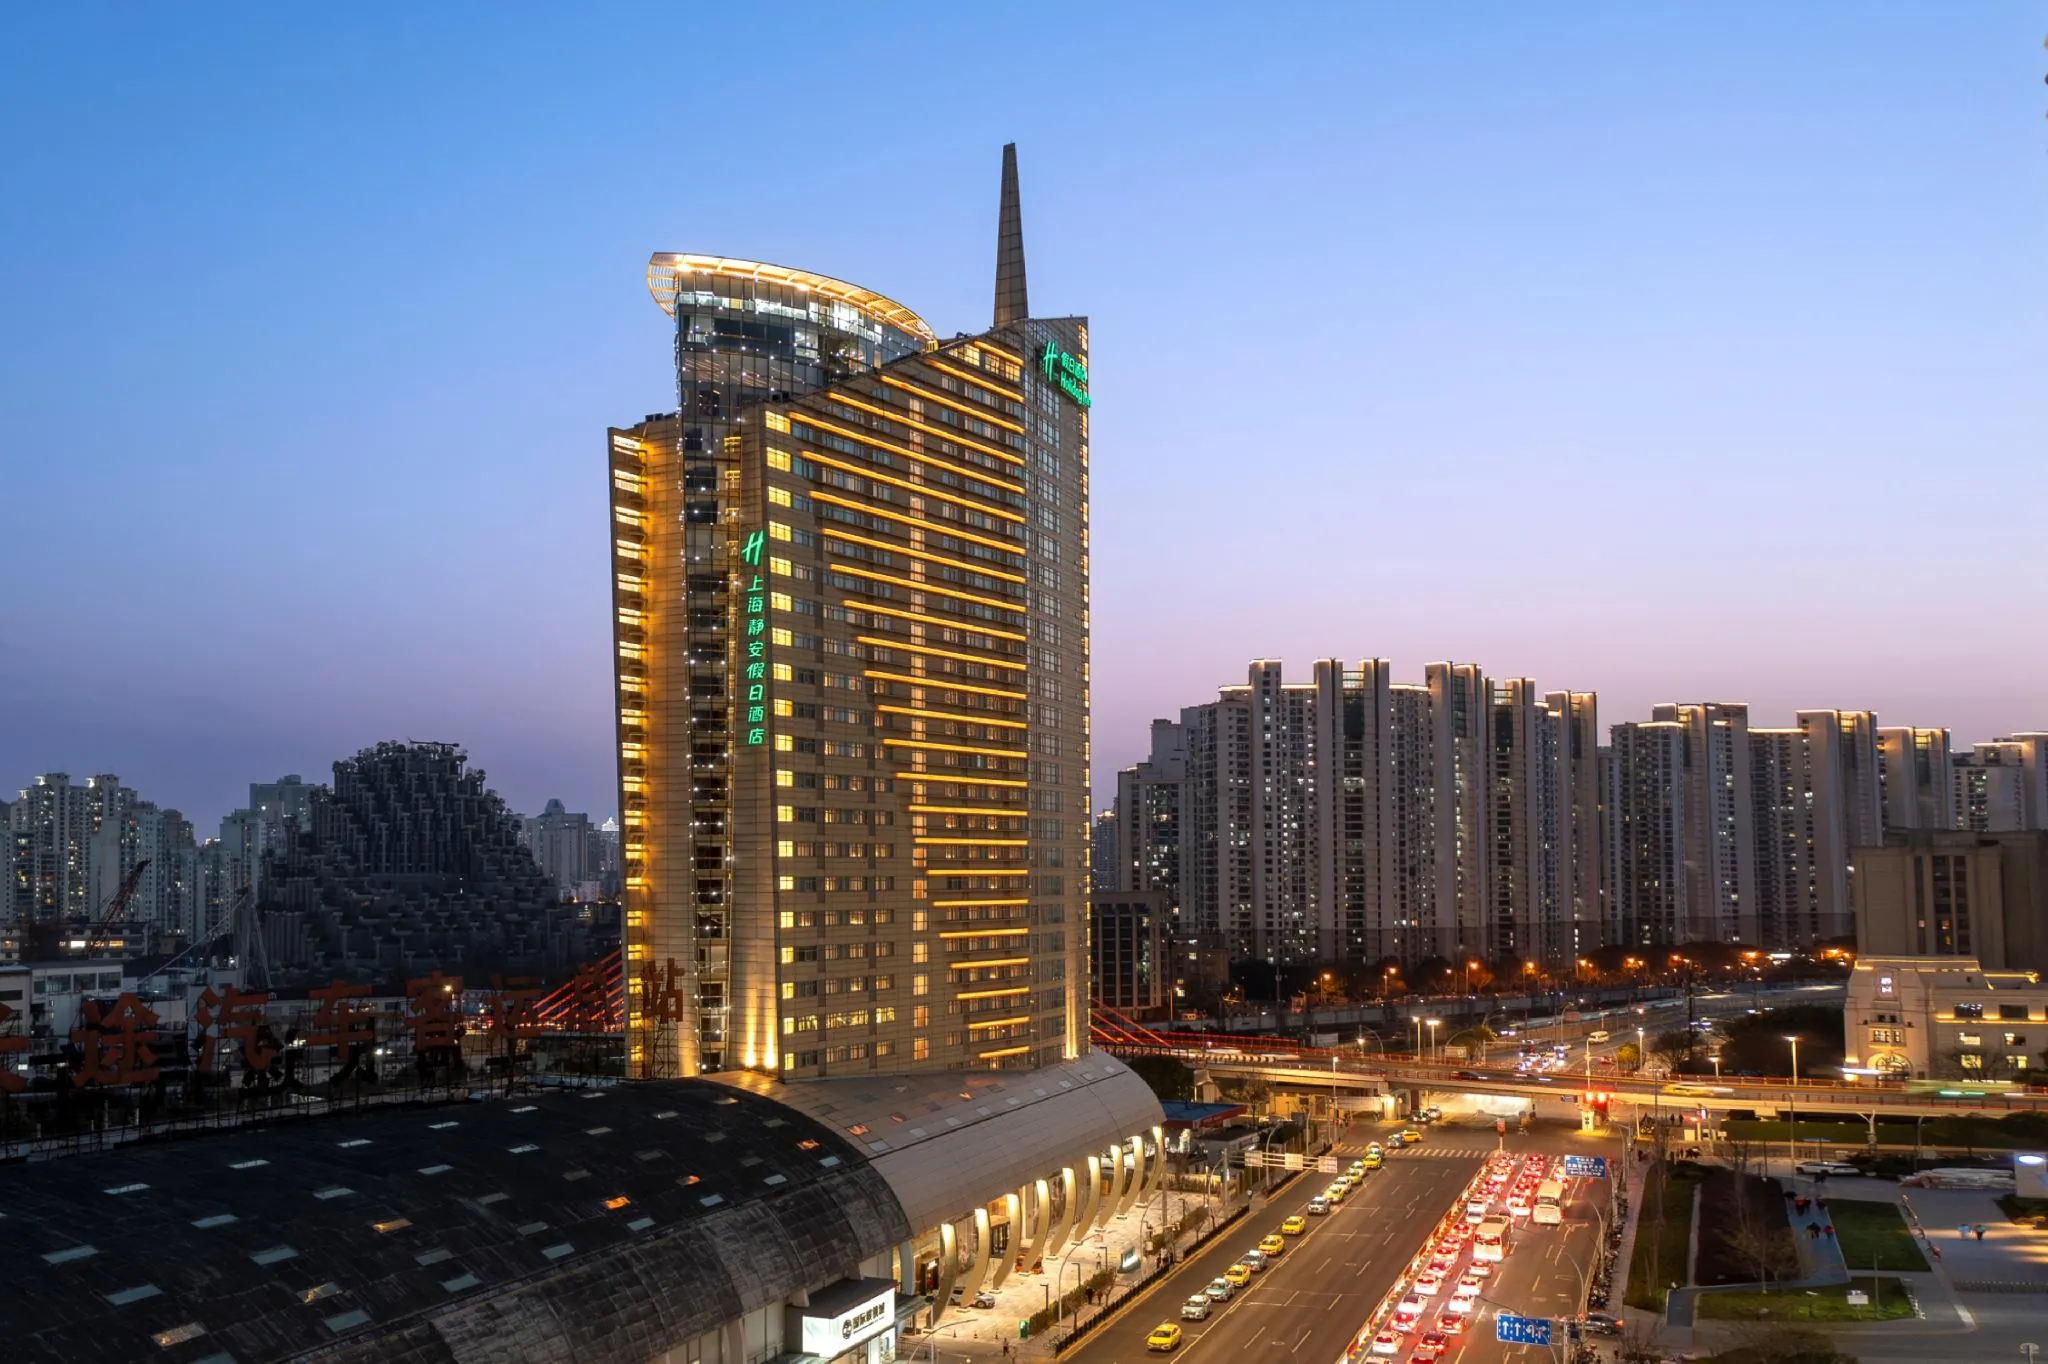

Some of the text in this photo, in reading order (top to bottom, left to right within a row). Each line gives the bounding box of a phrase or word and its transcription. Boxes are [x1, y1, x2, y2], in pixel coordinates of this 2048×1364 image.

[746, 574, 765, 745] 上海静安假日酒店
